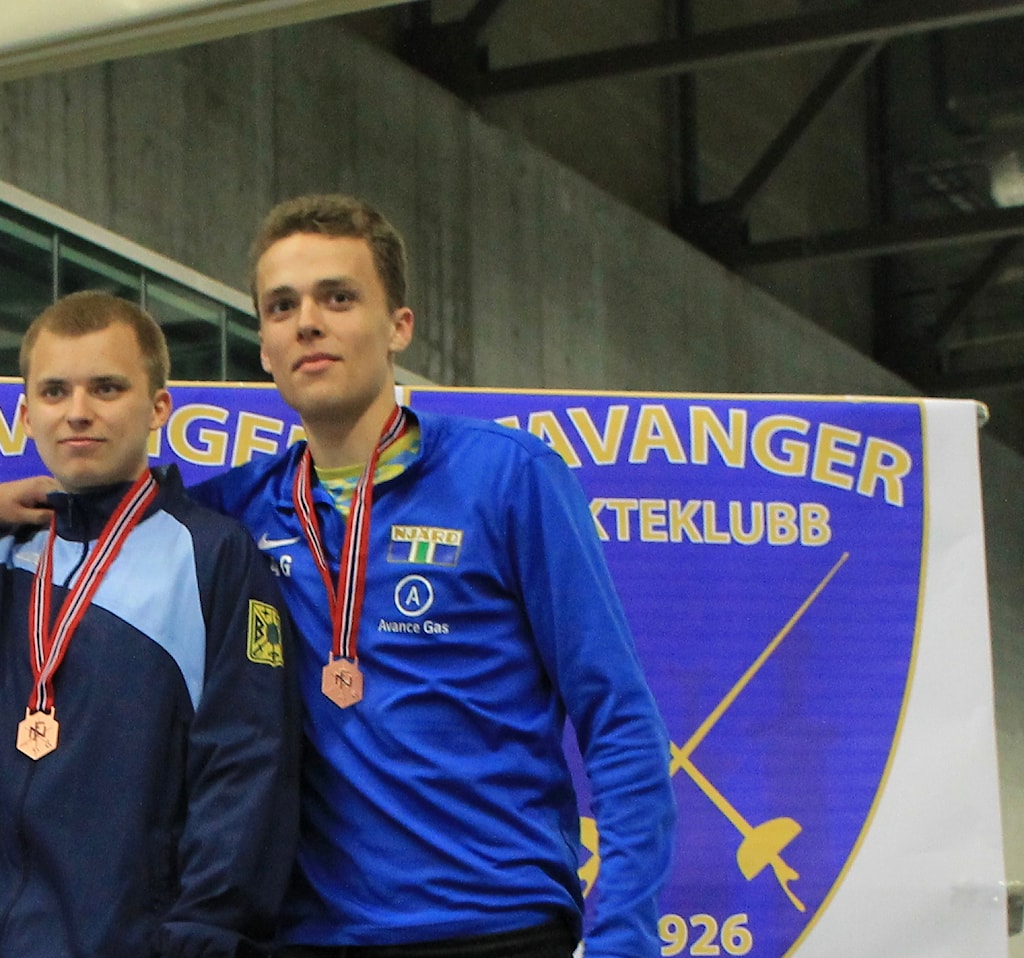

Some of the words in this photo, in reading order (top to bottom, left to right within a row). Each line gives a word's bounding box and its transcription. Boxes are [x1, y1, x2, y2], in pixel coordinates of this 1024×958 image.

[494, 404, 913, 507] AVANGER
[378, 618, 421, 635] Avance
[423, 619, 450, 635] Gas
